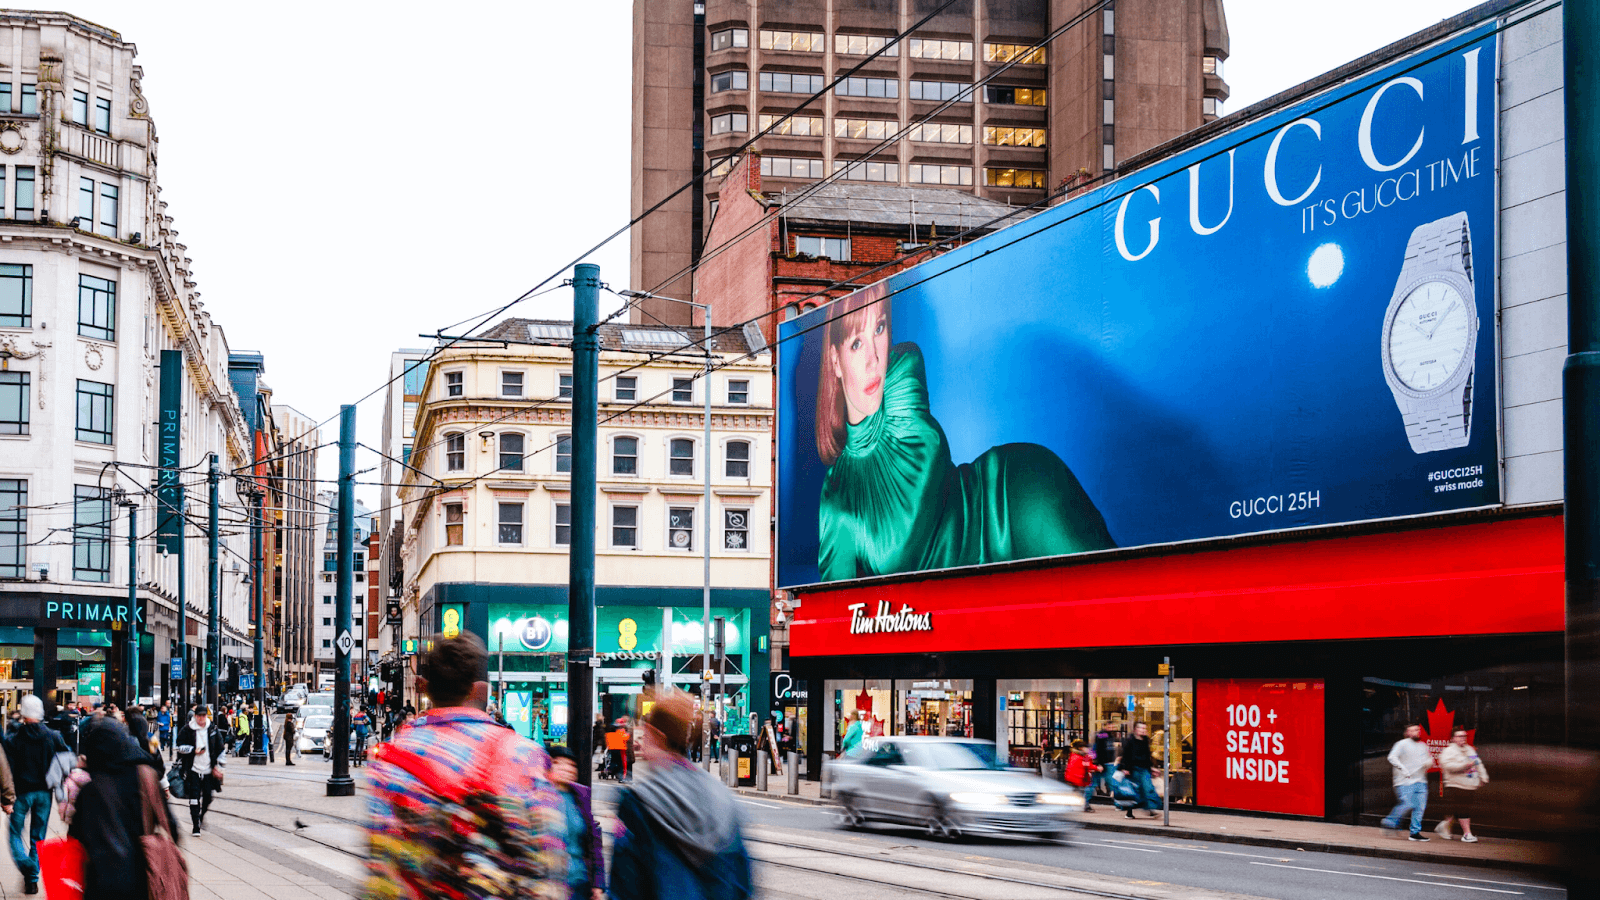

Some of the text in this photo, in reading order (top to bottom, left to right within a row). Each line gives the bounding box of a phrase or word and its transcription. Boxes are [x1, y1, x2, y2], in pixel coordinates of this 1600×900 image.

[1114, 46, 1482, 262] GUCCI
[1302, 146, 1481, 234] IT'S GUCCI TIME
[1418, 311, 1437, 320] GUCCI
[162, 410, 176, 493] PRIMARK
[1428, 465, 1483, 481] #GUCCI25H
[1434, 477, 1484, 493] swiss made
[1229, 489, 1320, 518] GUCCI 25H
[46, 601, 143, 623] PRIMARK
[848, 602, 874, 634] Tim
[341, 636, 351, 648] 10
[526, 626, 545, 639] BT
[1226, 704, 1278, 727] 100 +
[1226, 730, 1284, 755] SEATS
[1226, 757, 1289, 783] INSIDE
